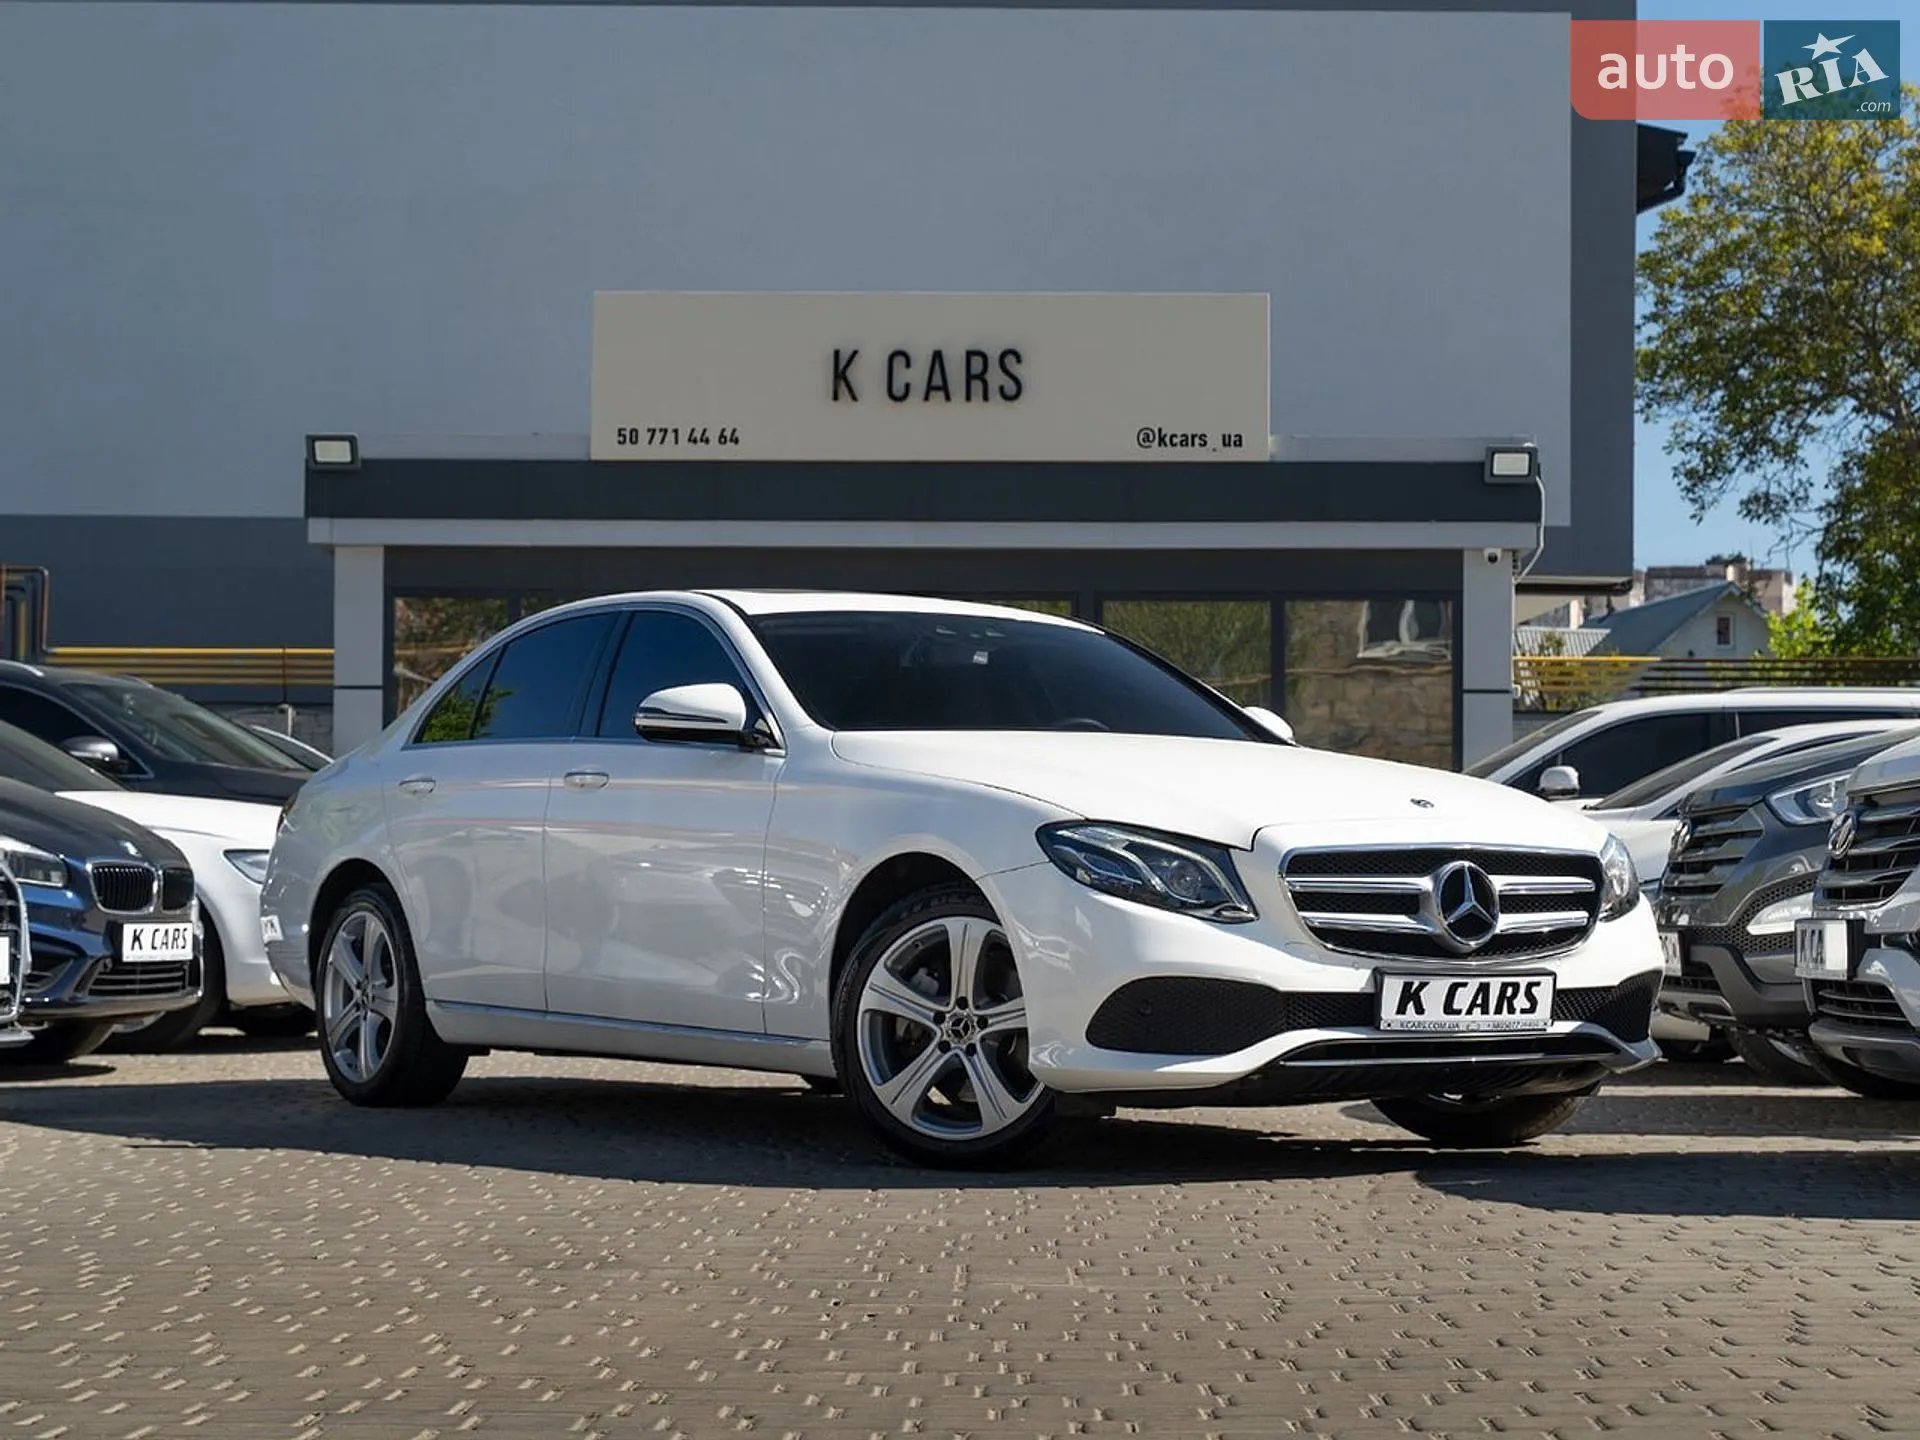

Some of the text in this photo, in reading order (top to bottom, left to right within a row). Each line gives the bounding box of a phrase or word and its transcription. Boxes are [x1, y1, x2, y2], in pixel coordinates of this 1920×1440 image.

[832, 348, 1023, 402] K CARS
[617, 427, 740, 445] 50 771 44 64
[131, 927, 188, 951] K CARS
[1395, 981, 1541, 1016] K CARS
